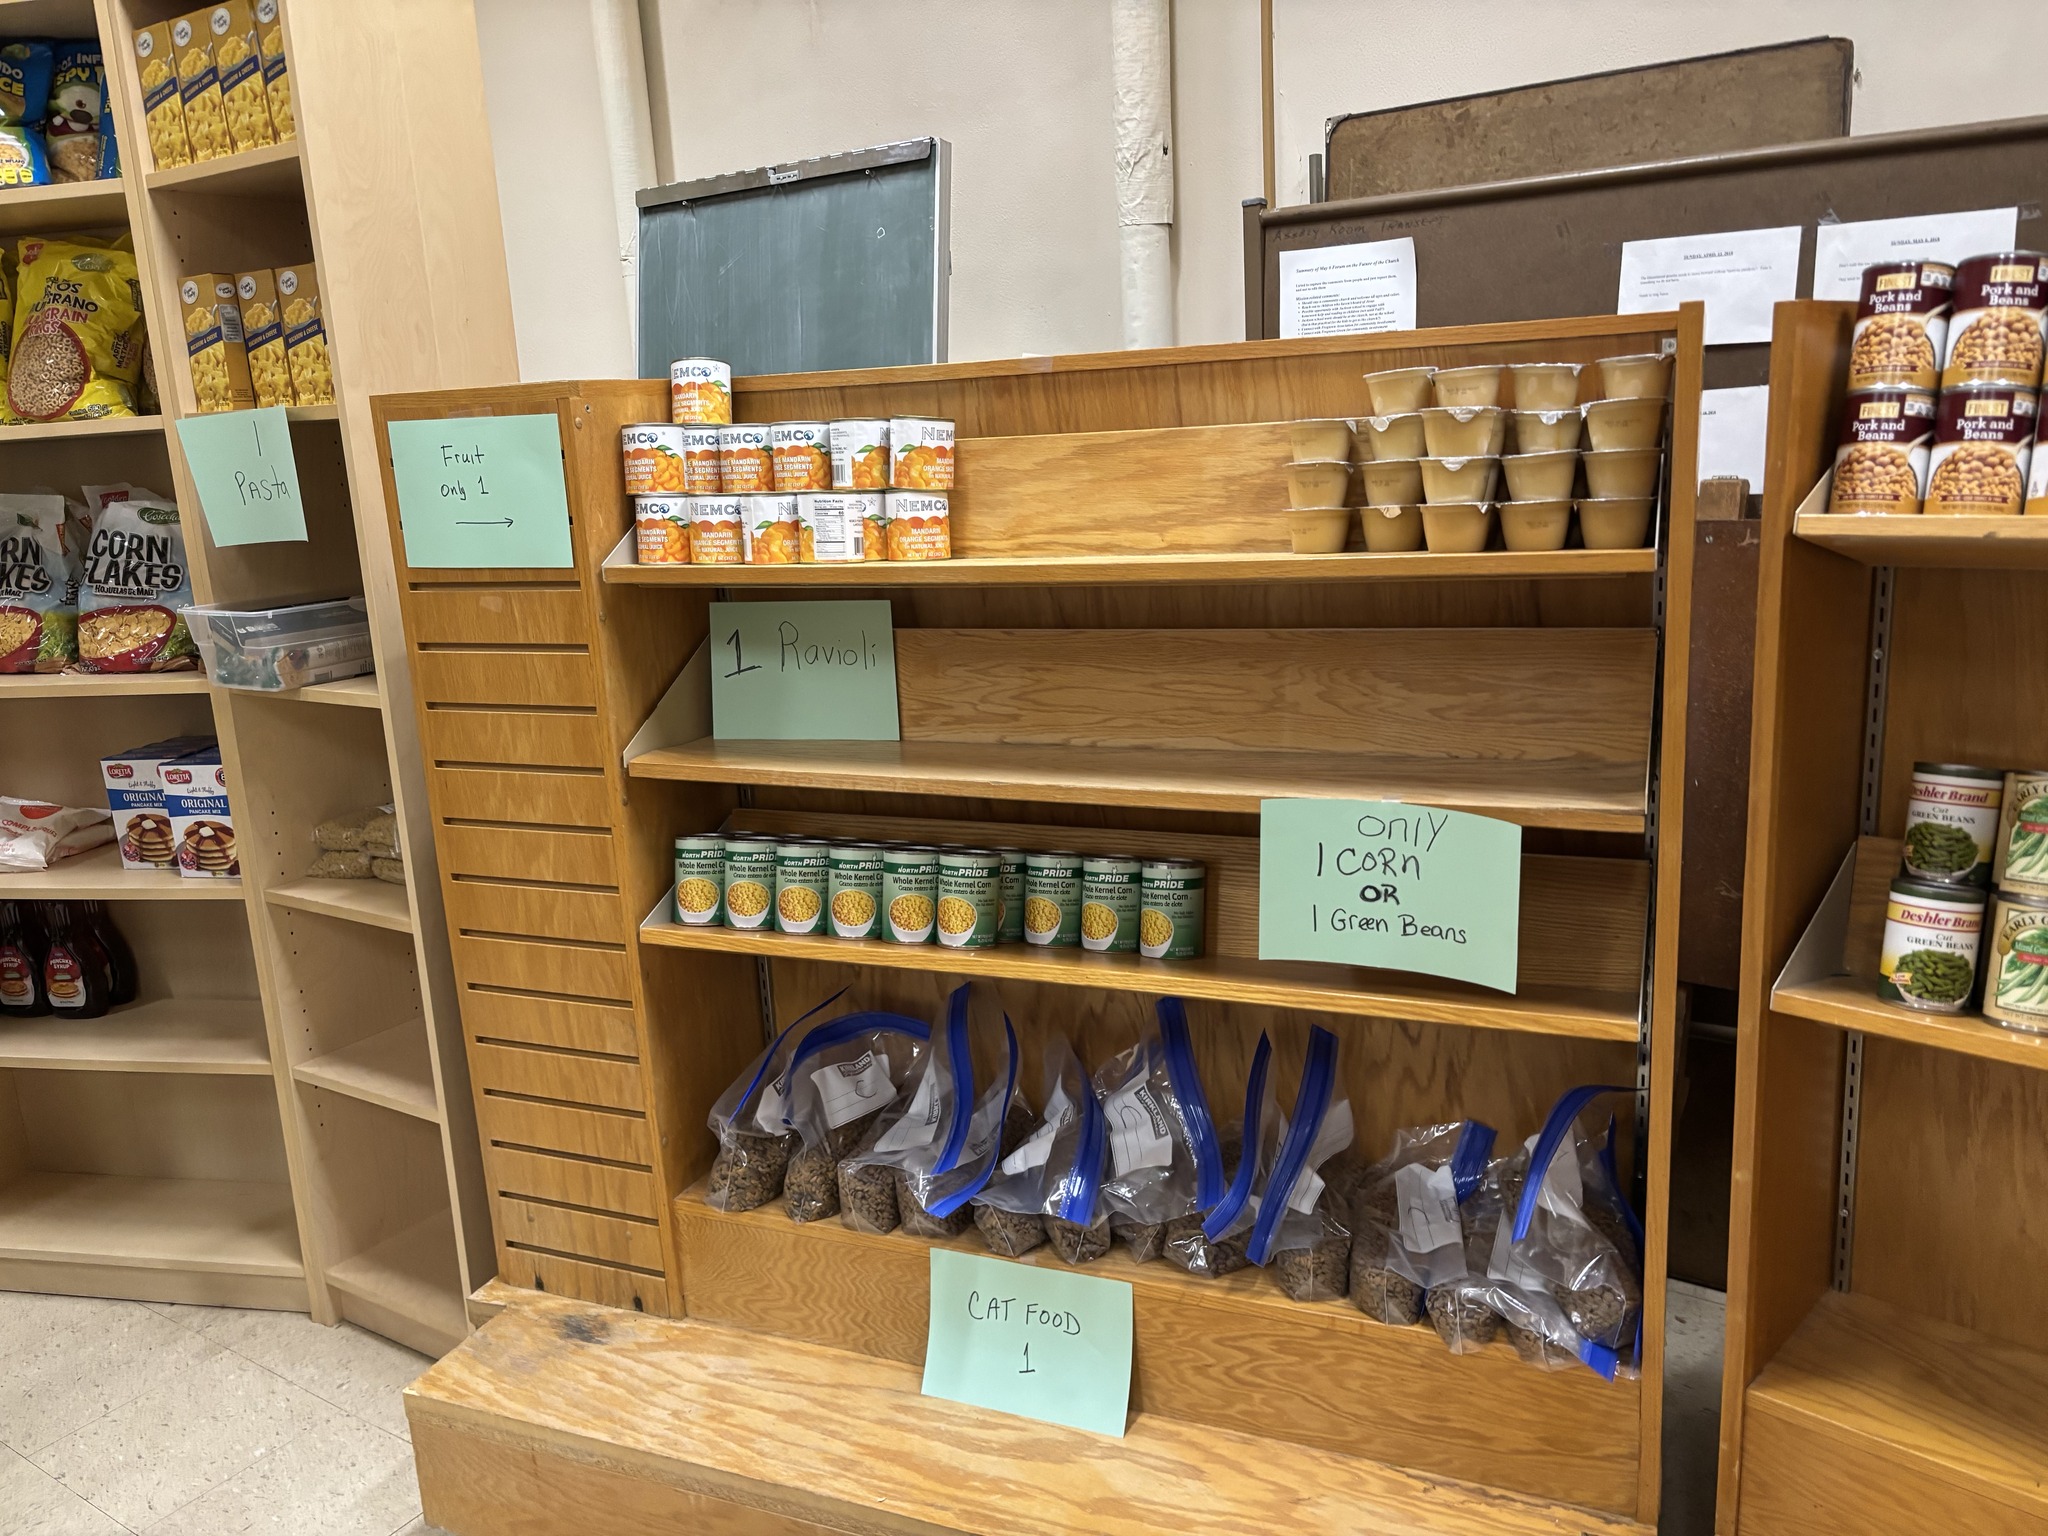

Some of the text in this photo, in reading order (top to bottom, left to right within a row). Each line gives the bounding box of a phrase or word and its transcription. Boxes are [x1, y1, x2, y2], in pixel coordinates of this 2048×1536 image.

[1981, 284, 2038, 297] Pork and
[1869, 290, 1922, 305] Pork and
[1989, 295, 2029, 306] Beans
[1875, 302, 1912, 314] Beans
[672, 366, 712, 380] EMCO
[1852, 420, 1905, 432] Pork and
[1956, 418, 2014, 431] Pork and
[1858, 430, 1894, 441] Beans
[1964, 429, 2003, 440] Beans
[440, 445, 485, 468] Fruit
[479, 476, 490, 496] 1
[896, 499, 947, 512] NEMCO
[92, 529, 169, 565] CORN
[724, 621, 876, 678] 1 Ravioli
[108, 766, 132, 776] LORETTA
[166, 772, 190, 782] LORETTA
[1948, 789, 1988, 802] Brand
[2013, 785, 2040, 812] EARLY
[182, 799, 227, 808] ORIGINAL
[1912, 810, 1976, 824] GREEN BEANS
[700, 850, 726, 858] PRID
[752, 854, 777, 862] PRID
[748, 864, 769, 872] Kernel
[803, 858, 829, 866] PRIDE
[858, 862, 884, 870] PRIDE
[1043, 869, 1072, 877] PRIDE
[1099, 874, 1130, 882] PRIDE
[954, 880, 975, 888] Kernel
[1039, 880, 1060, 888] Kernel
[1095, 885, 1116, 894] Kernel
[1154, 880, 1185, 888] PRIDE
[1359, 884, 1400, 905] OR
[1901, 910, 1952, 927] Deshler
[1331, 908, 1388, 933] Green
[1398, 914, 1467, 944] Beans
[2003, 915, 2037, 940] EARLY
[1907, 936, 1943, 948] GREEN
[1140, 1089, 1166, 1135] KIRKLAND
[968, 1290, 1081, 1336] CAT FOOD
[1019, 1342, 1036, 1374] 1
